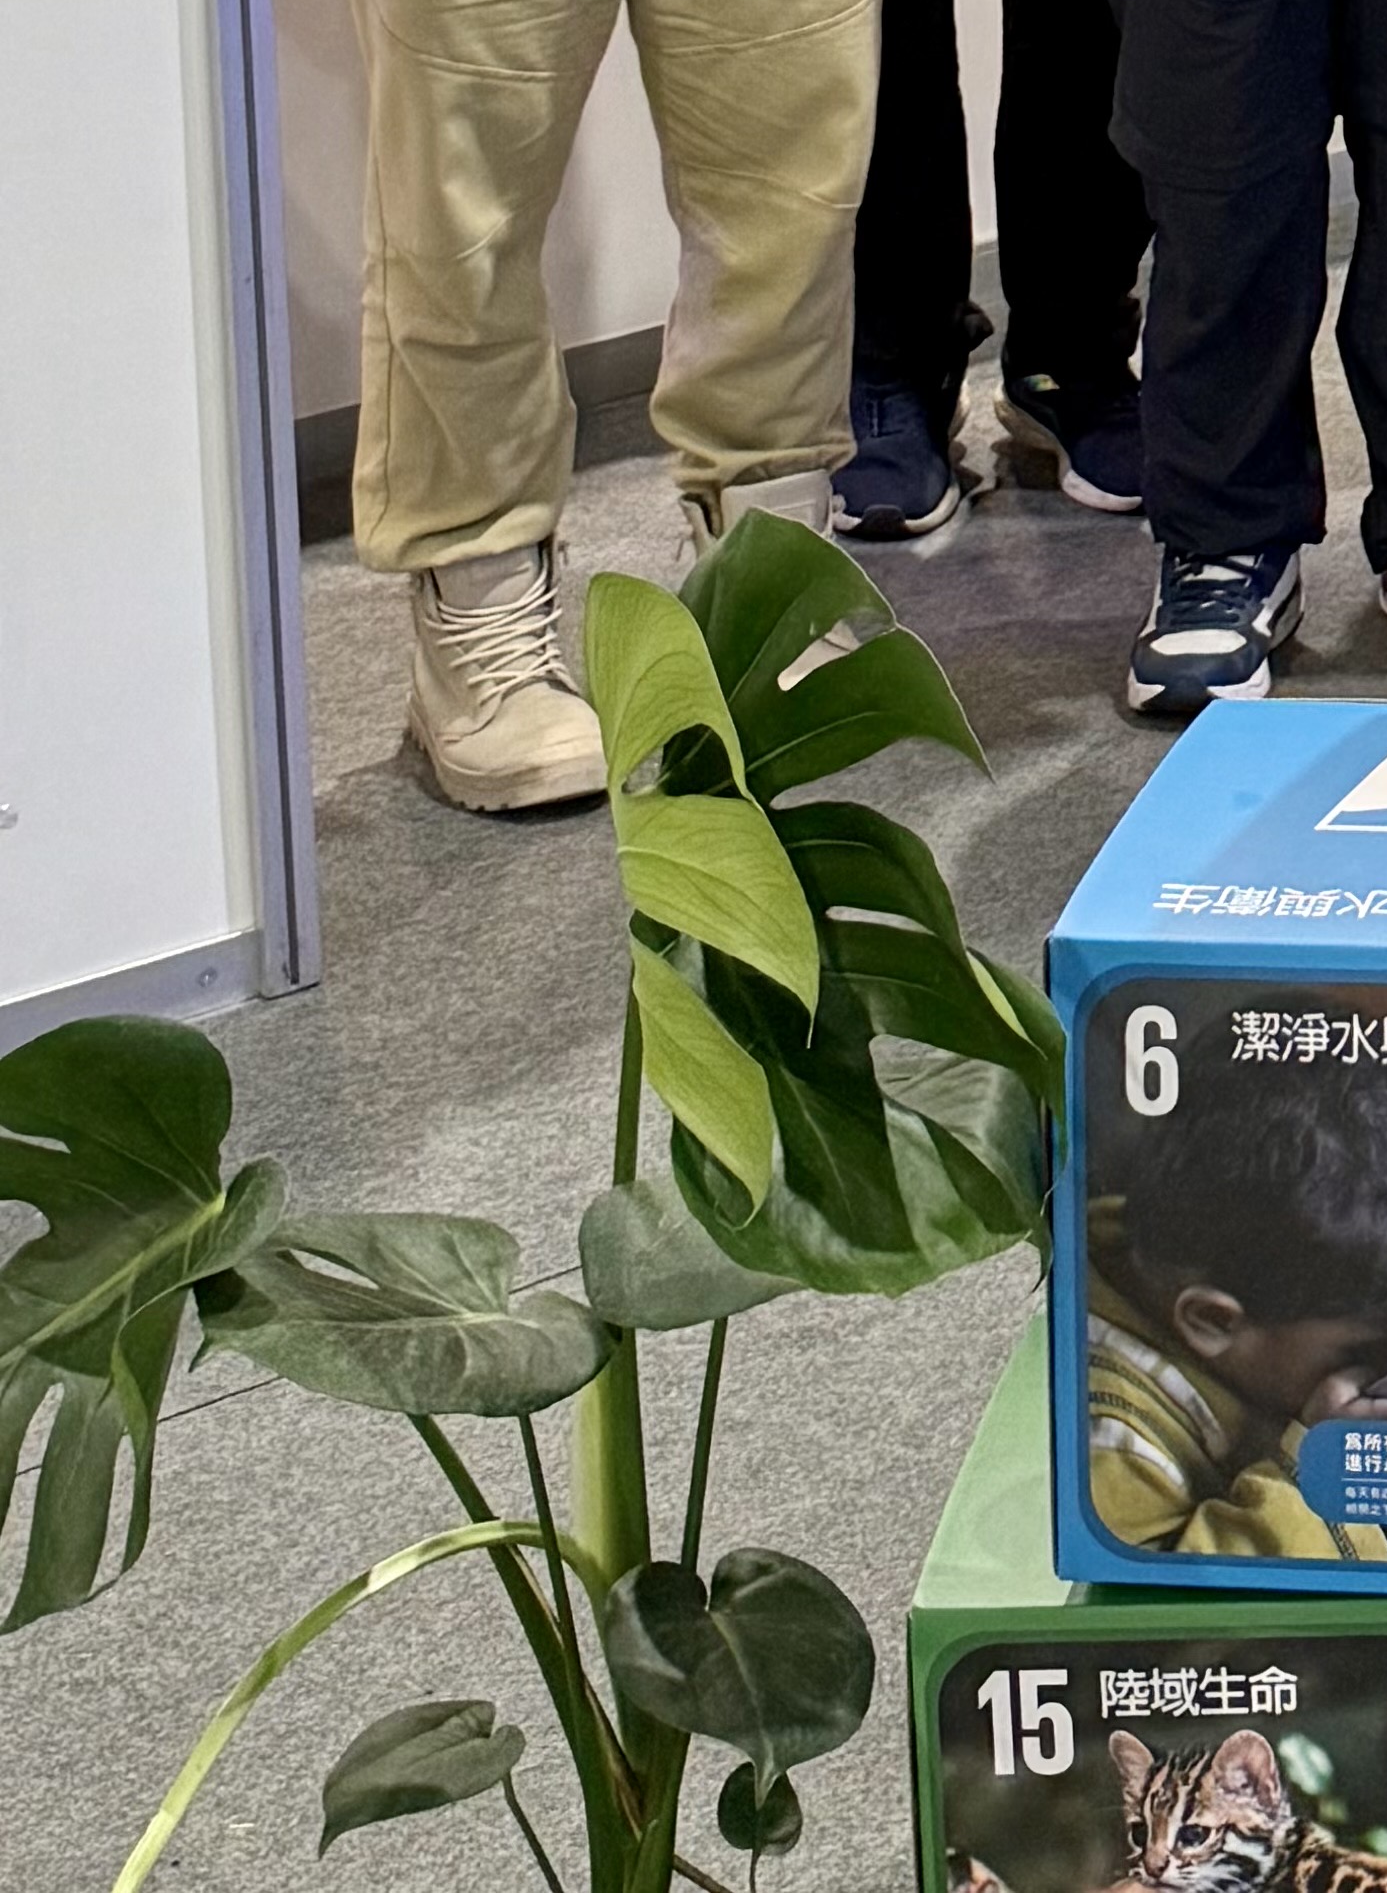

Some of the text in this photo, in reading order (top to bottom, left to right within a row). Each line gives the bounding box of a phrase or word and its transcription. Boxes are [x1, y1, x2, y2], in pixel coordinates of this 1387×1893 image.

[1122, 1003, 1181, 1118] 6
[977, 1668, 1074, 1776] 15
[1099, 1665, 1299, 1719] 陸域生命
